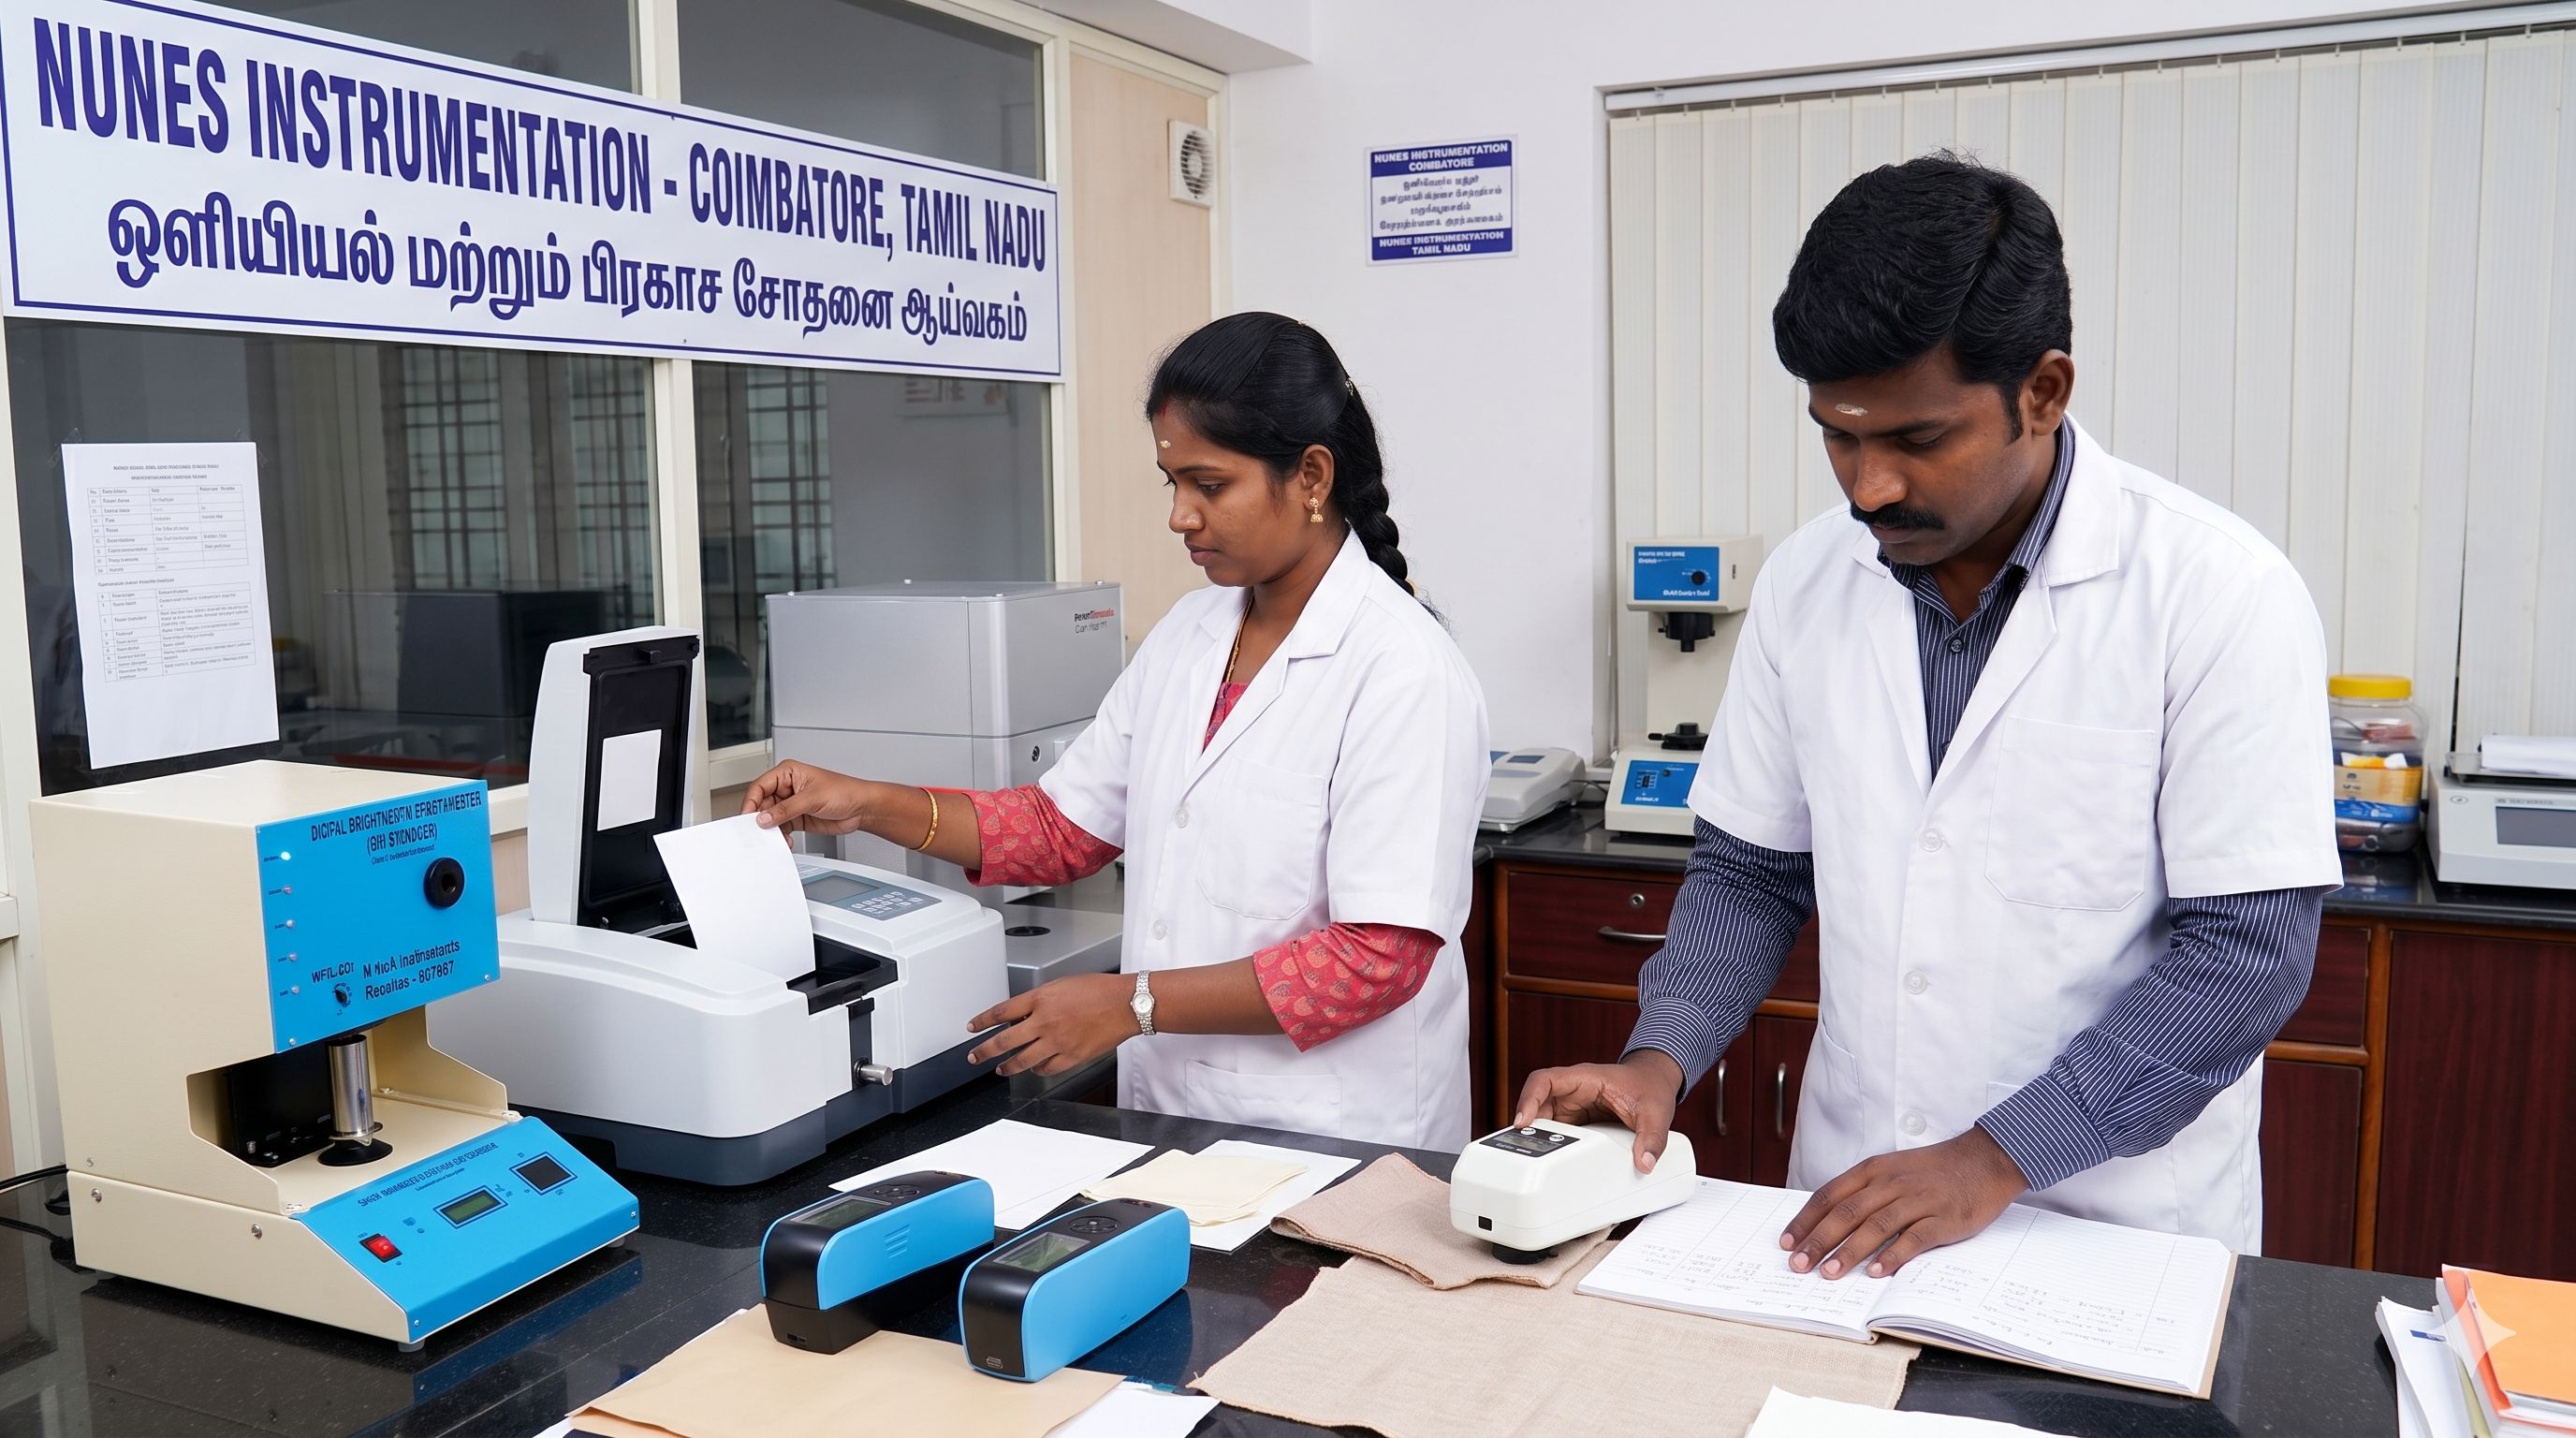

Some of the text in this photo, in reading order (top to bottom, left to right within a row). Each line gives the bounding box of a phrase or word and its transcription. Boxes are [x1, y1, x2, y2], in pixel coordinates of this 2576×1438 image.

[34, 17, 1046, 271] NUNES INSTRUMENTATION - COIMBATORE, TAMIL NADU
[1374, 152, 1409, 163] NUNES
[108, 191, 1028, 345] ஒளியியல் மற்றும் பிரகாச சோதனை ஆய்வகம்
[1412, 243, 1471, 256] TAMIL NADU
